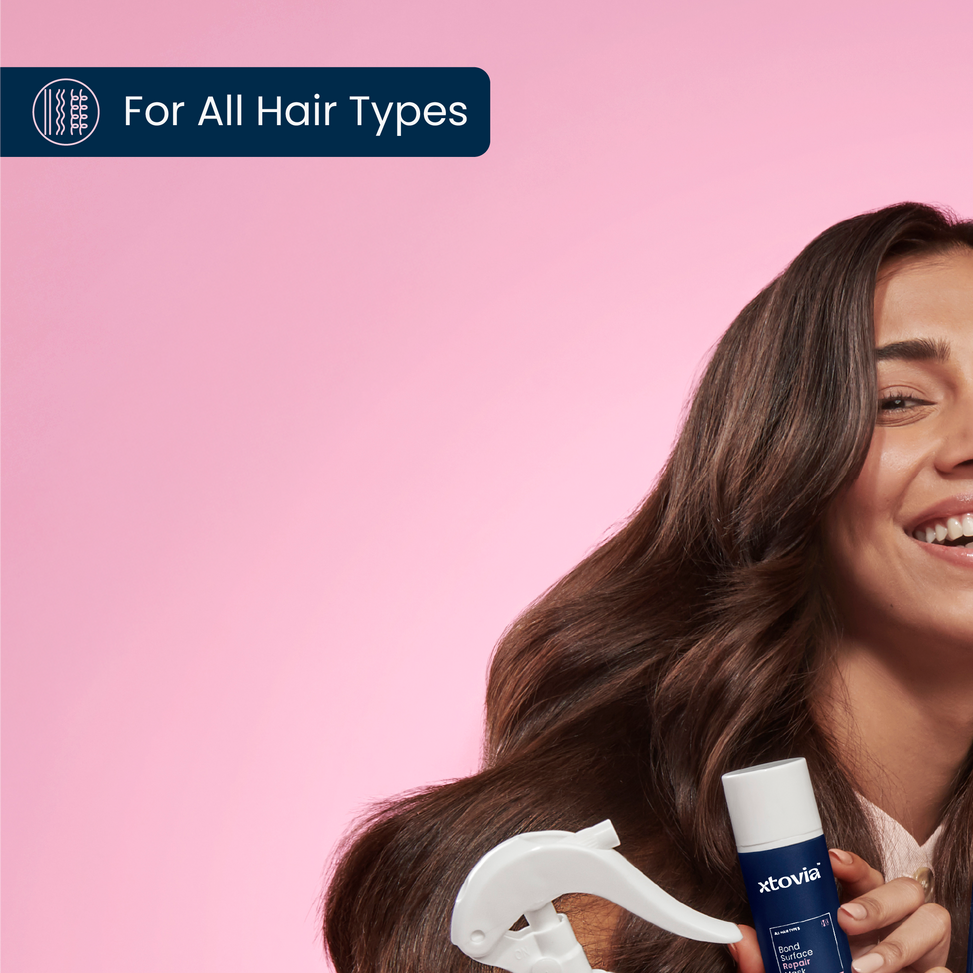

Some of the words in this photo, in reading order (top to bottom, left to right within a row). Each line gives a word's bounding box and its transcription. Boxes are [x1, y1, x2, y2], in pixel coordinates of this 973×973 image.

[778, 942, 800, 954] Bond
[780, 949, 814, 962] Surface
[782, 958, 811, 970] Repair
